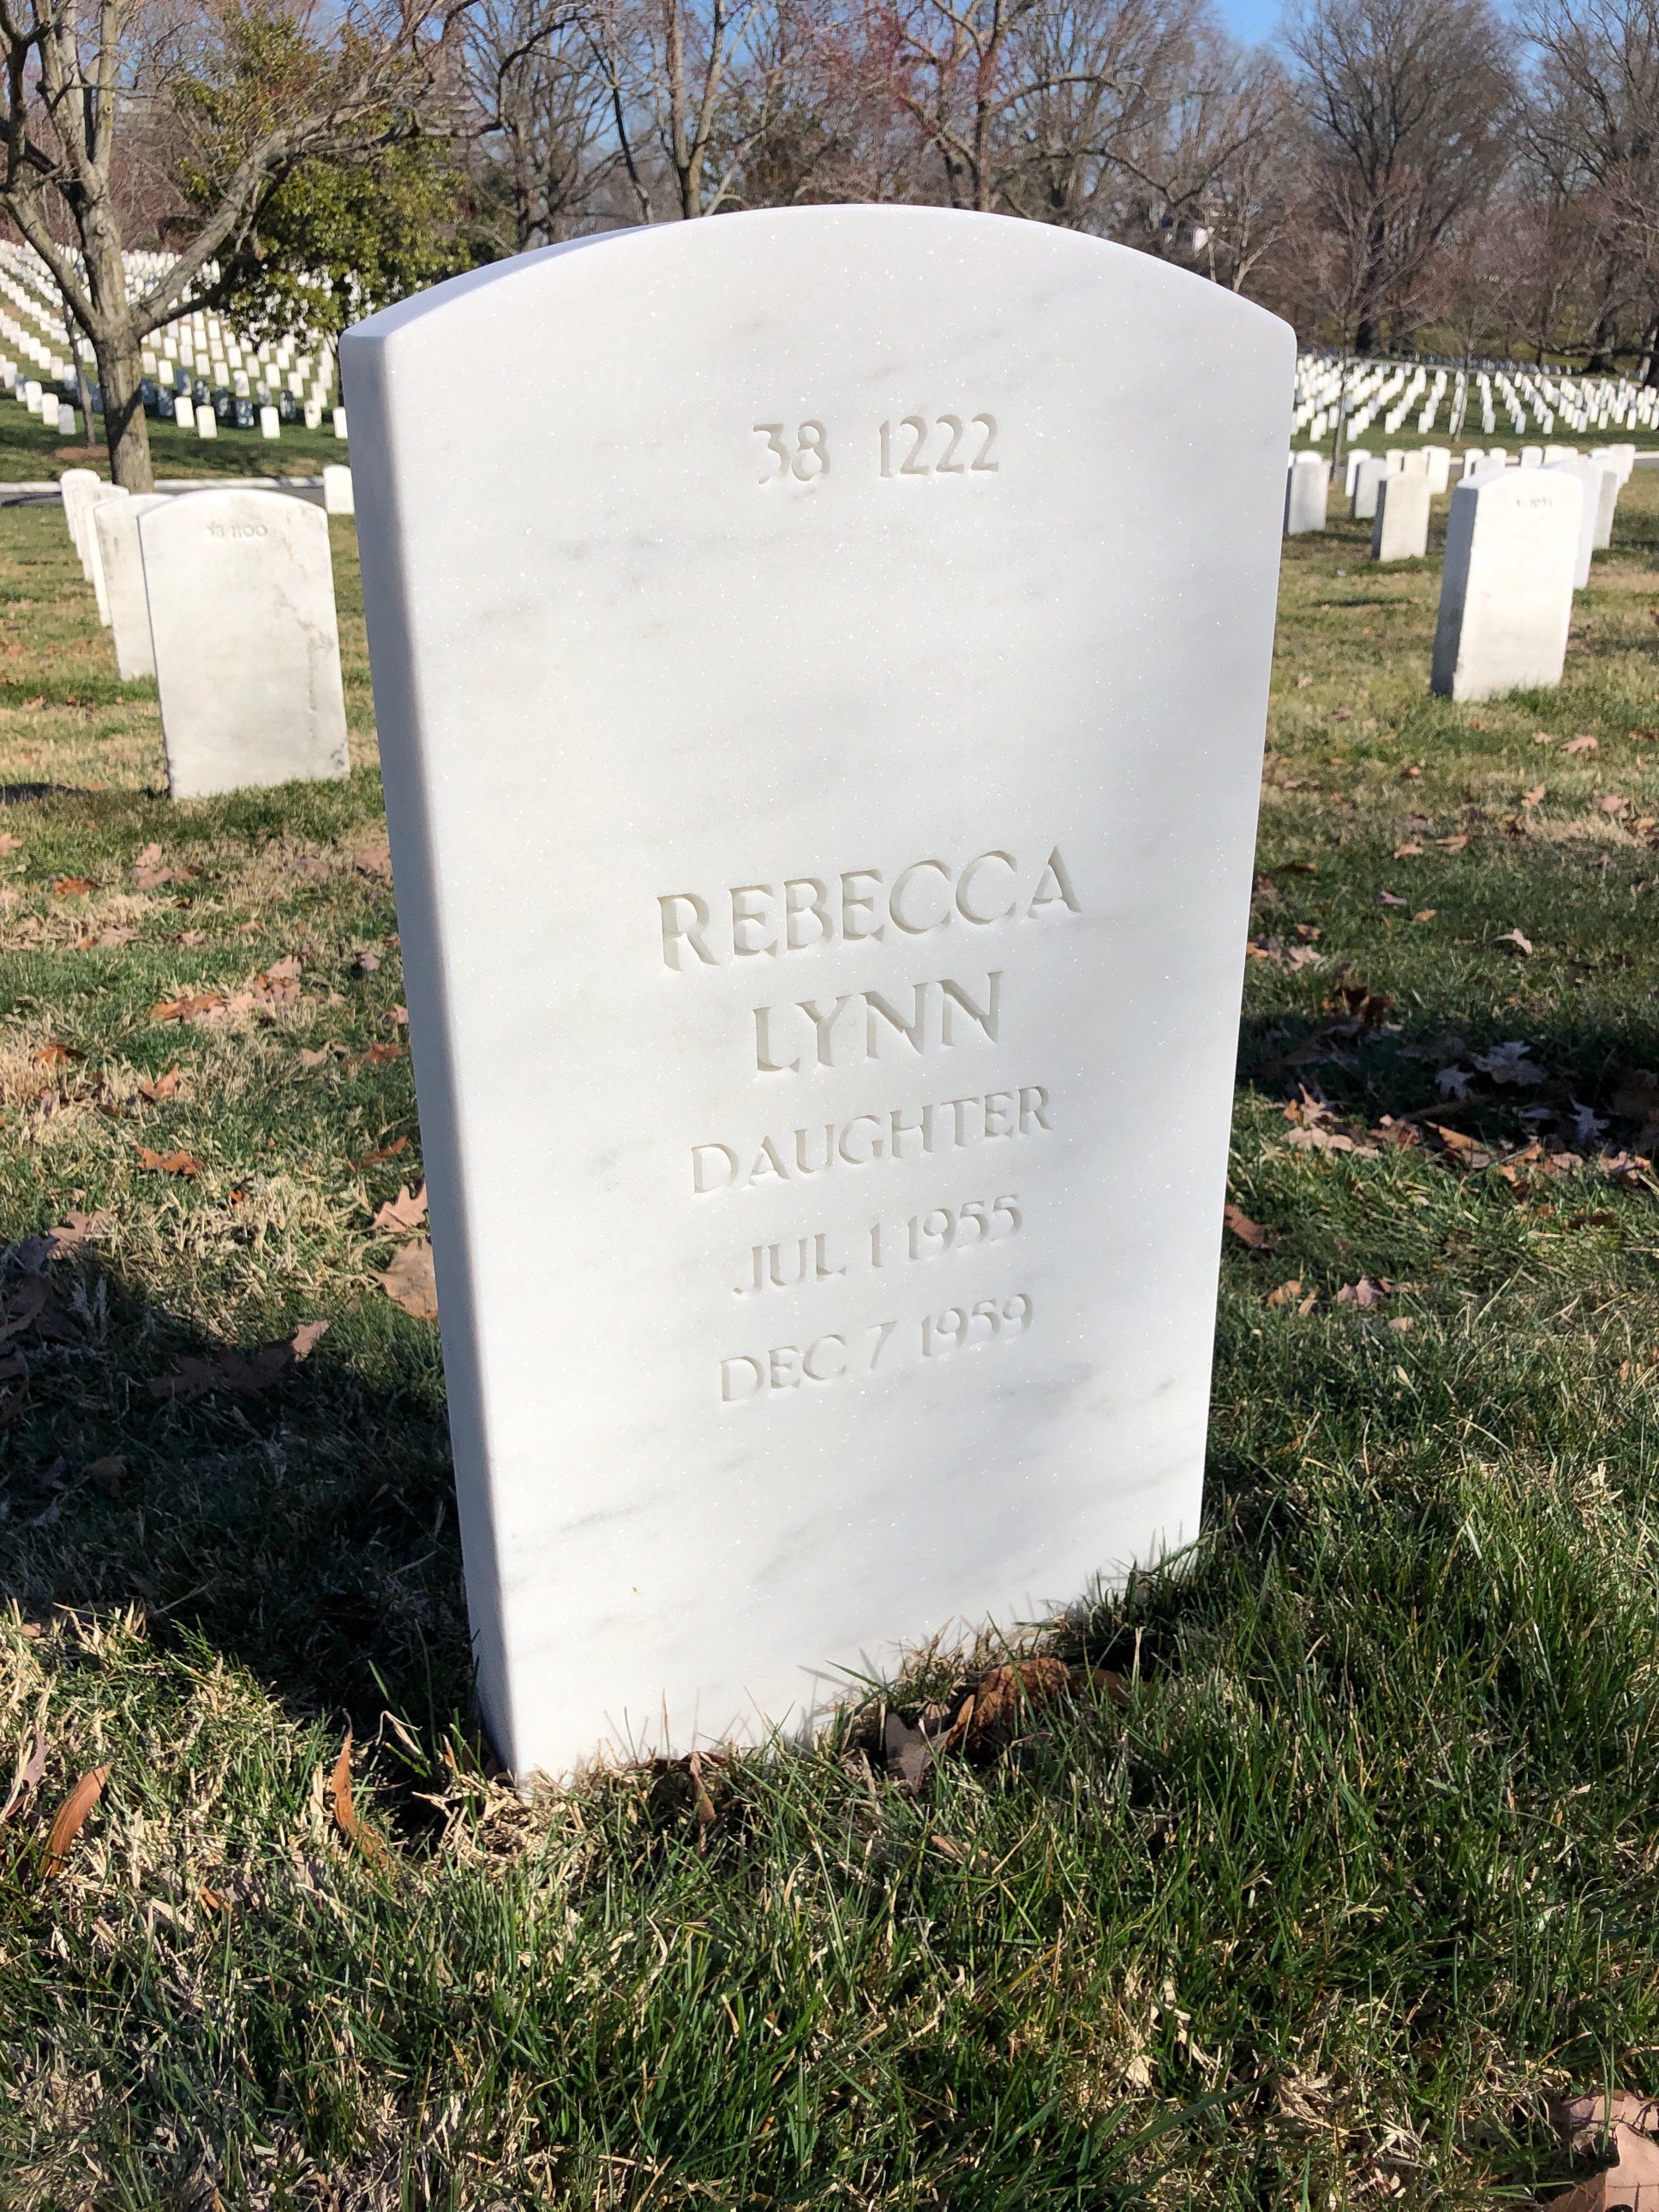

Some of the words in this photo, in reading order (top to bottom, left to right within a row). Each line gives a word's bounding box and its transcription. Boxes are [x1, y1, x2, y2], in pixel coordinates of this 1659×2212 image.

[752, 420, 830, 484] 38
[878, 412, 999, 478] 1222
[656, 845, 1082, 971] REBECCA
[752, 970, 1003, 1073] LYNN
[691, 1086, 1053, 1193] DAUGHTER
[733, 1233, 847, 1295] JUL
[869, 1222, 883, 1268] 1
[907, 1194, 1023, 1261] 1955
[720, 1334, 847, 1402] DEC
[867, 1321, 899, 1370] 7
[920, 1292, 1034, 1358] 1959
